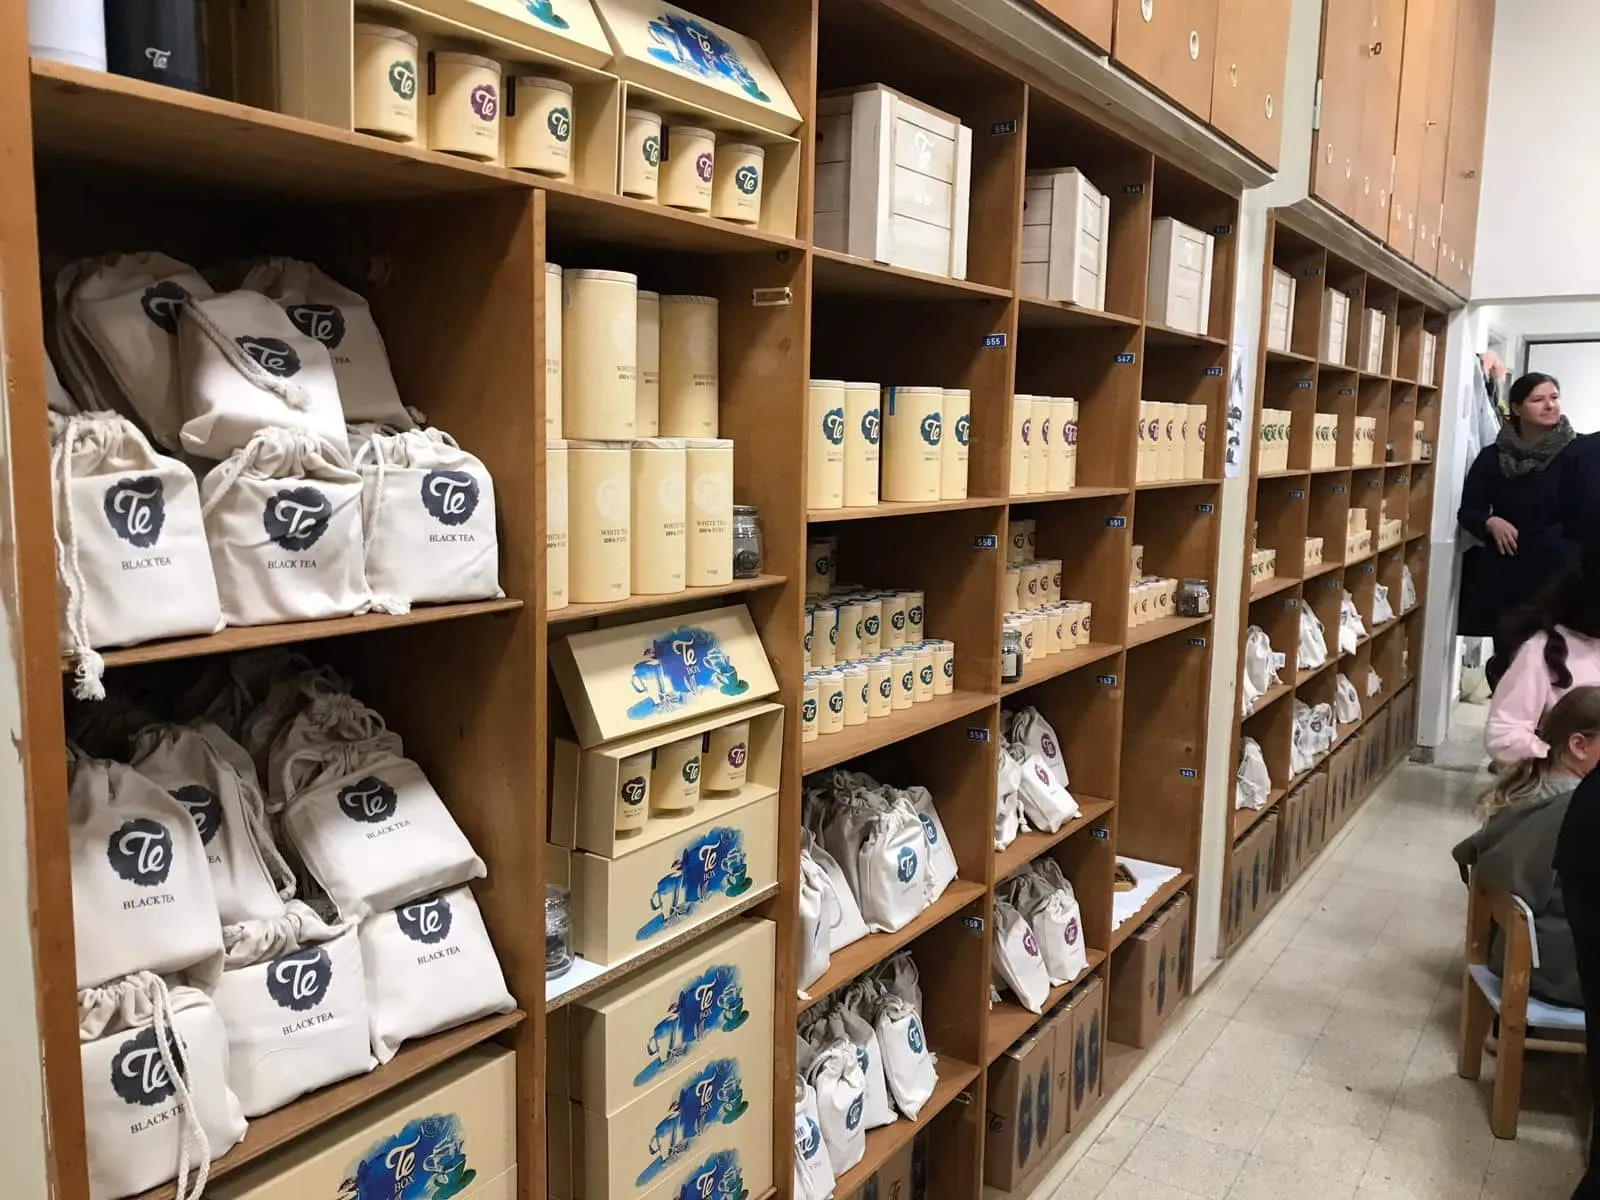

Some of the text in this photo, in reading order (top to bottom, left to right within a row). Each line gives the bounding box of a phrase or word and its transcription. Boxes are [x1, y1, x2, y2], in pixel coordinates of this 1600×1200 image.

[145, 48, 171, 69] Te
[393, 66, 413, 92] Te
[475, 90, 497, 115] Te
[551, 112, 569, 137] Te
[739, 169, 755, 190] Te
[293, 308, 334, 340] Te
[242, 341, 289, 370] Te
[827, 415, 843, 438] Te
[925, 419, 941, 440] Te
[430, 476, 472, 514] Te
[114, 489, 159, 535] Te
[274, 500, 324, 538] Te
[429, 534, 475, 542] BLACK TEA
[121, 557, 171, 570] BLACK TEA
[267, 559, 317, 569] BLACK TEA
[673, 638, 697, 666] Te
[345, 784, 387, 816] Te
[366, 819, 411, 840] BLACK TEA
[119, 830, 165, 874] Te
[699, 840, 720, 871] Te
[122, 894, 175, 910] BLACK TEA
[402, 899, 442, 935] Te
[416, 945, 461, 965] BLACK TEA
[275, 952, 321, 1000] Te
[696, 978, 717, 1010] Te
[282, 1012, 334, 1036] BLACK TEA
[121, 1047, 170, 1093] Te
[696, 1072, 717, 1106] Te
[130, 1103, 184, 1134] BLACK TE
[386, 1134, 421, 1181] Te
[394, 1175, 415, 1192] BOX
[696, 1161, 718, 1198] Te
